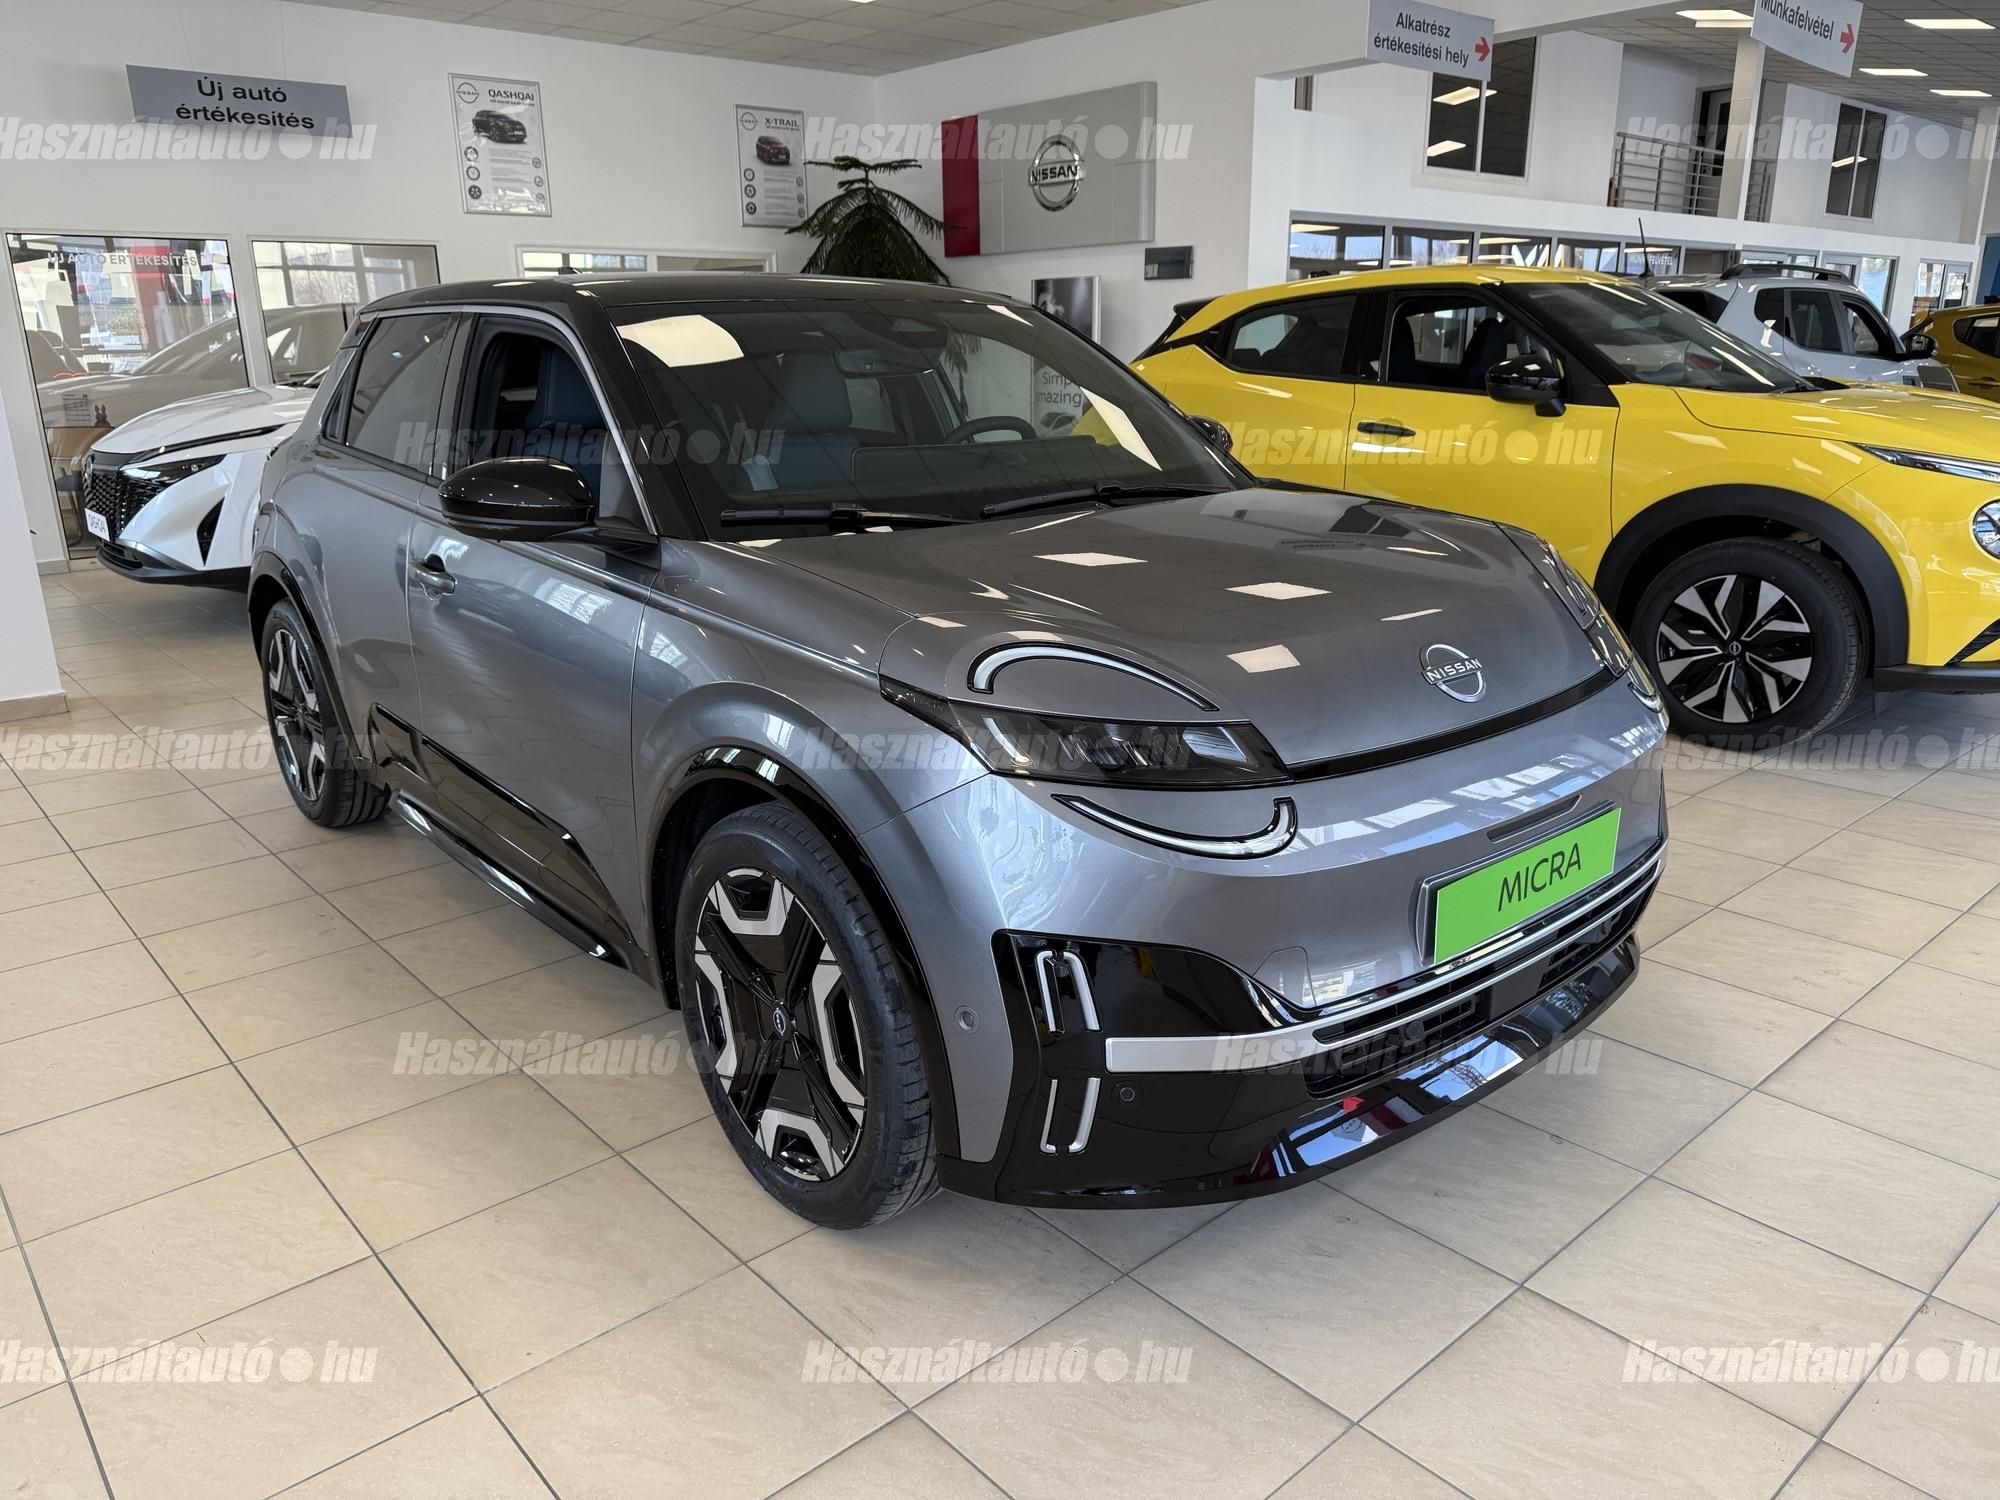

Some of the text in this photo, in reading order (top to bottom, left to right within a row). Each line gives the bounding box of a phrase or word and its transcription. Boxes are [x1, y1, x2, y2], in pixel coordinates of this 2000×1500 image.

[1396, 12, 1451, 38] Alkatrész
[1374, 33, 1469, 68] értékesítési hely
[197, 76, 287, 103] Új autó
[488, 89, 535, 101] QASHQAI
[176, 103, 314, 129] értékesítés
[1031, 164, 1078, 185] NISSAN
[1426, 658, 1483, 681] NISSAN
[1497, 843, 1582, 912] MICRA
